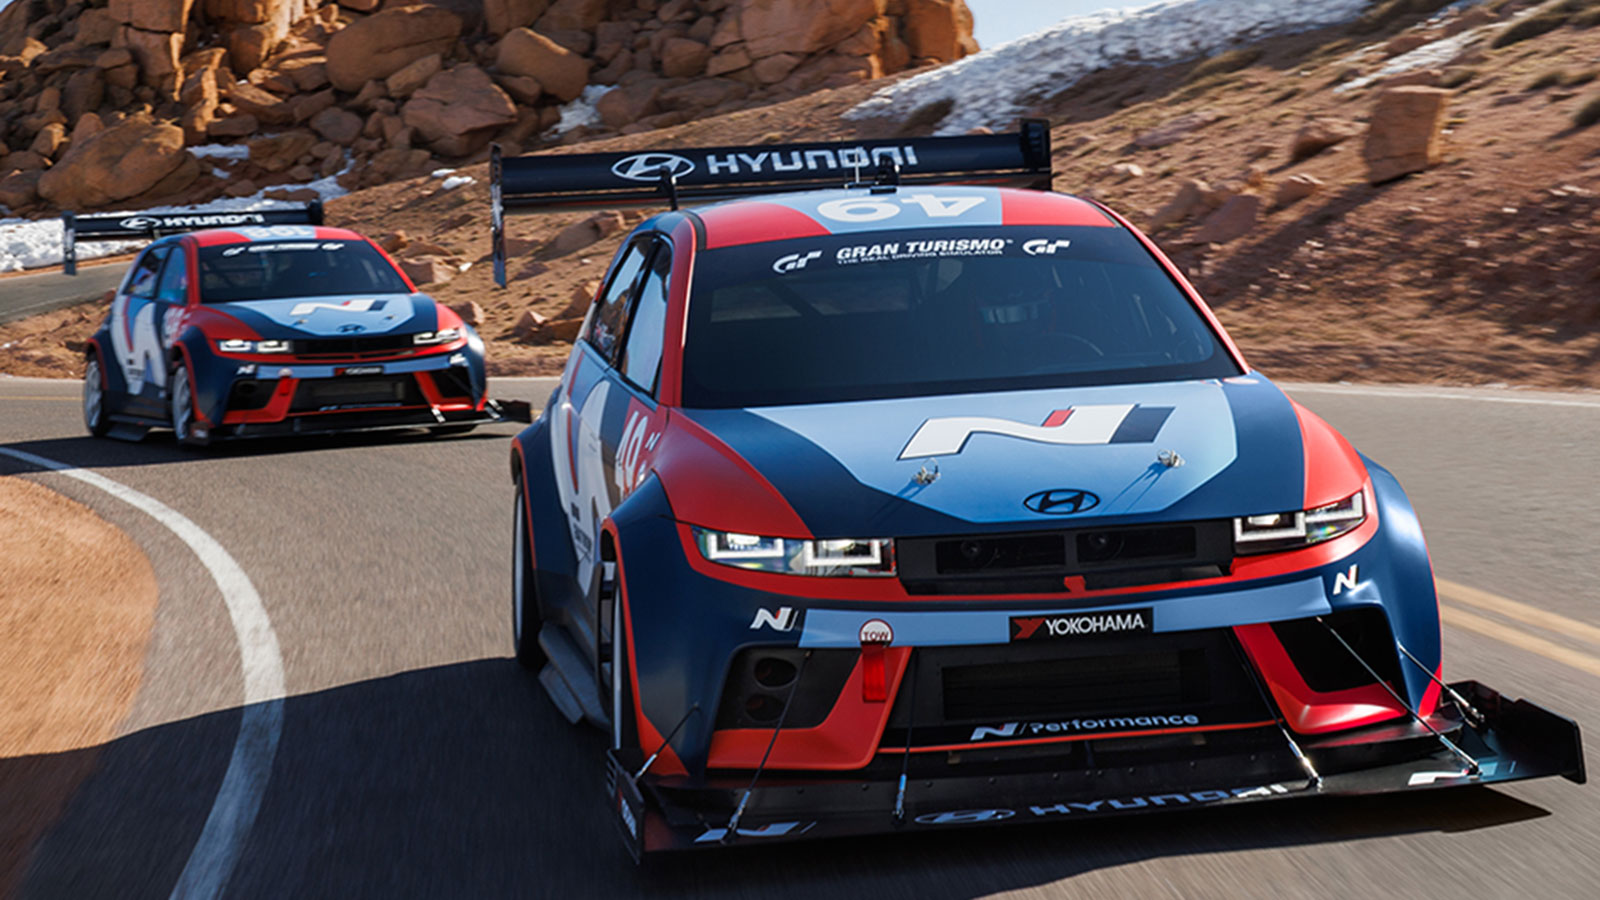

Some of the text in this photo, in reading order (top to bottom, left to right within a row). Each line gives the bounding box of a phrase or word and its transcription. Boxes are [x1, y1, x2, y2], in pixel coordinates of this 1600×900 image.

[706, 146, 918, 174] HYUNDAI
[817, 193, 986, 222] 49
[836, 239, 1006, 260] GRAN TURISMO
[861, 254, 891, 262] REAL
[892, 252, 937, 260] DRIVING
[939, 249, 1003, 257] SIMULATOR
[1045, 613, 1145, 636] YOKOHAMA
[863, 631, 889, 643] TOW
[1029, 714, 1199, 734] Performance
[1030, 784, 1288, 816] HYUNDAI
